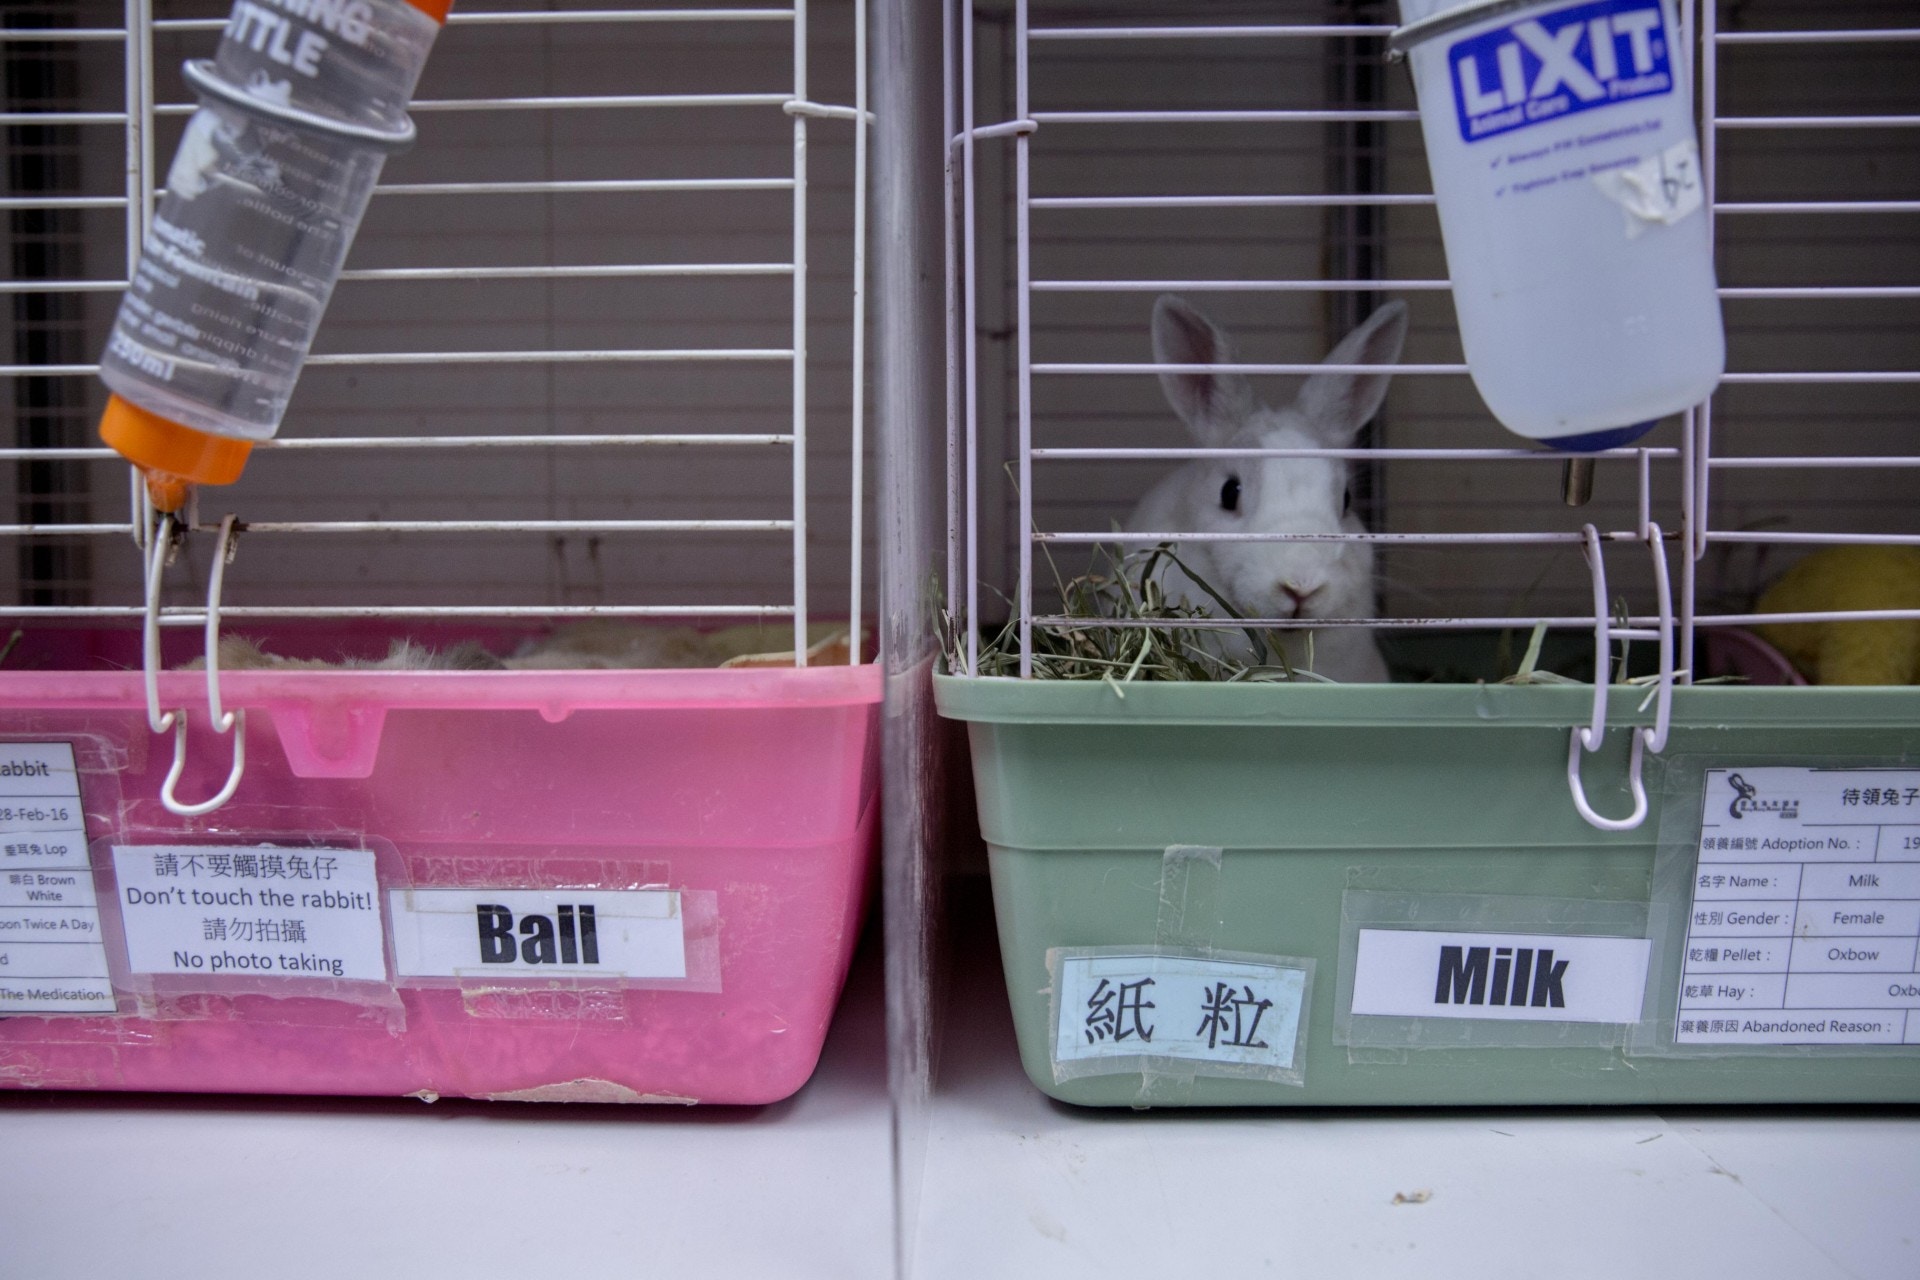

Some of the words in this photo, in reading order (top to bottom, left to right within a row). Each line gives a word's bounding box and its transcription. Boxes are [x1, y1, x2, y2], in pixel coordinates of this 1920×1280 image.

[1458, 8, 1661, 118] LIXIT
[0, 761, 49, 776] abbit
[44, 844, 68, 856] Lop
[1703, 837, 1758, 850] 領養編號
[1761, 837, 1824, 852] Adoption
[1828, 837, 1850, 850] No.
[154, 853, 338, 881] 請不要觸摸兔仔
[37, 874, 76, 886] Brown
[1698, 875, 1726, 888] 名字
[1729, 876, 1768, 887] Name
[1849, 875, 1880, 887] Milk
[27, 890, 63, 902] White
[192, 889, 252, 907] touch
[259, 890, 295, 907] the
[302, 890, 372, 910] rabbit!
[1694, 911, 1723, 925] 性別
[1727, 912, 1780, 925] Gender
[1833, 912, 1884, 924] Female
[24, 919, 57, 930] Twice
[60, 919, 70, 930] A
[72, 919, 94, 932] Day
[203, 918, 308, 943] 請勿拍攝
[476, 904, 600, 964] Ball
[1689, 949, 1718, 962] 乾糧
[1723, 948, 1762, 961] Pellet
[1828, 947, 1880, 961] Oxbow
[174, 951, 203, 968] No
[211, 950, 273, 972] photo
[279, 952, 345, 976] taking
[1435, 945, 1571, 1008] Milk
[27, 988, 105, 1000] Medication
[1685, 985, 1713, 998] 乾草
[1718, 985, 1745, 1000] Hay
[1742, 1020, 1825, 1033] Abandoned
[1829, 1020, 1882, 1033] Reason
